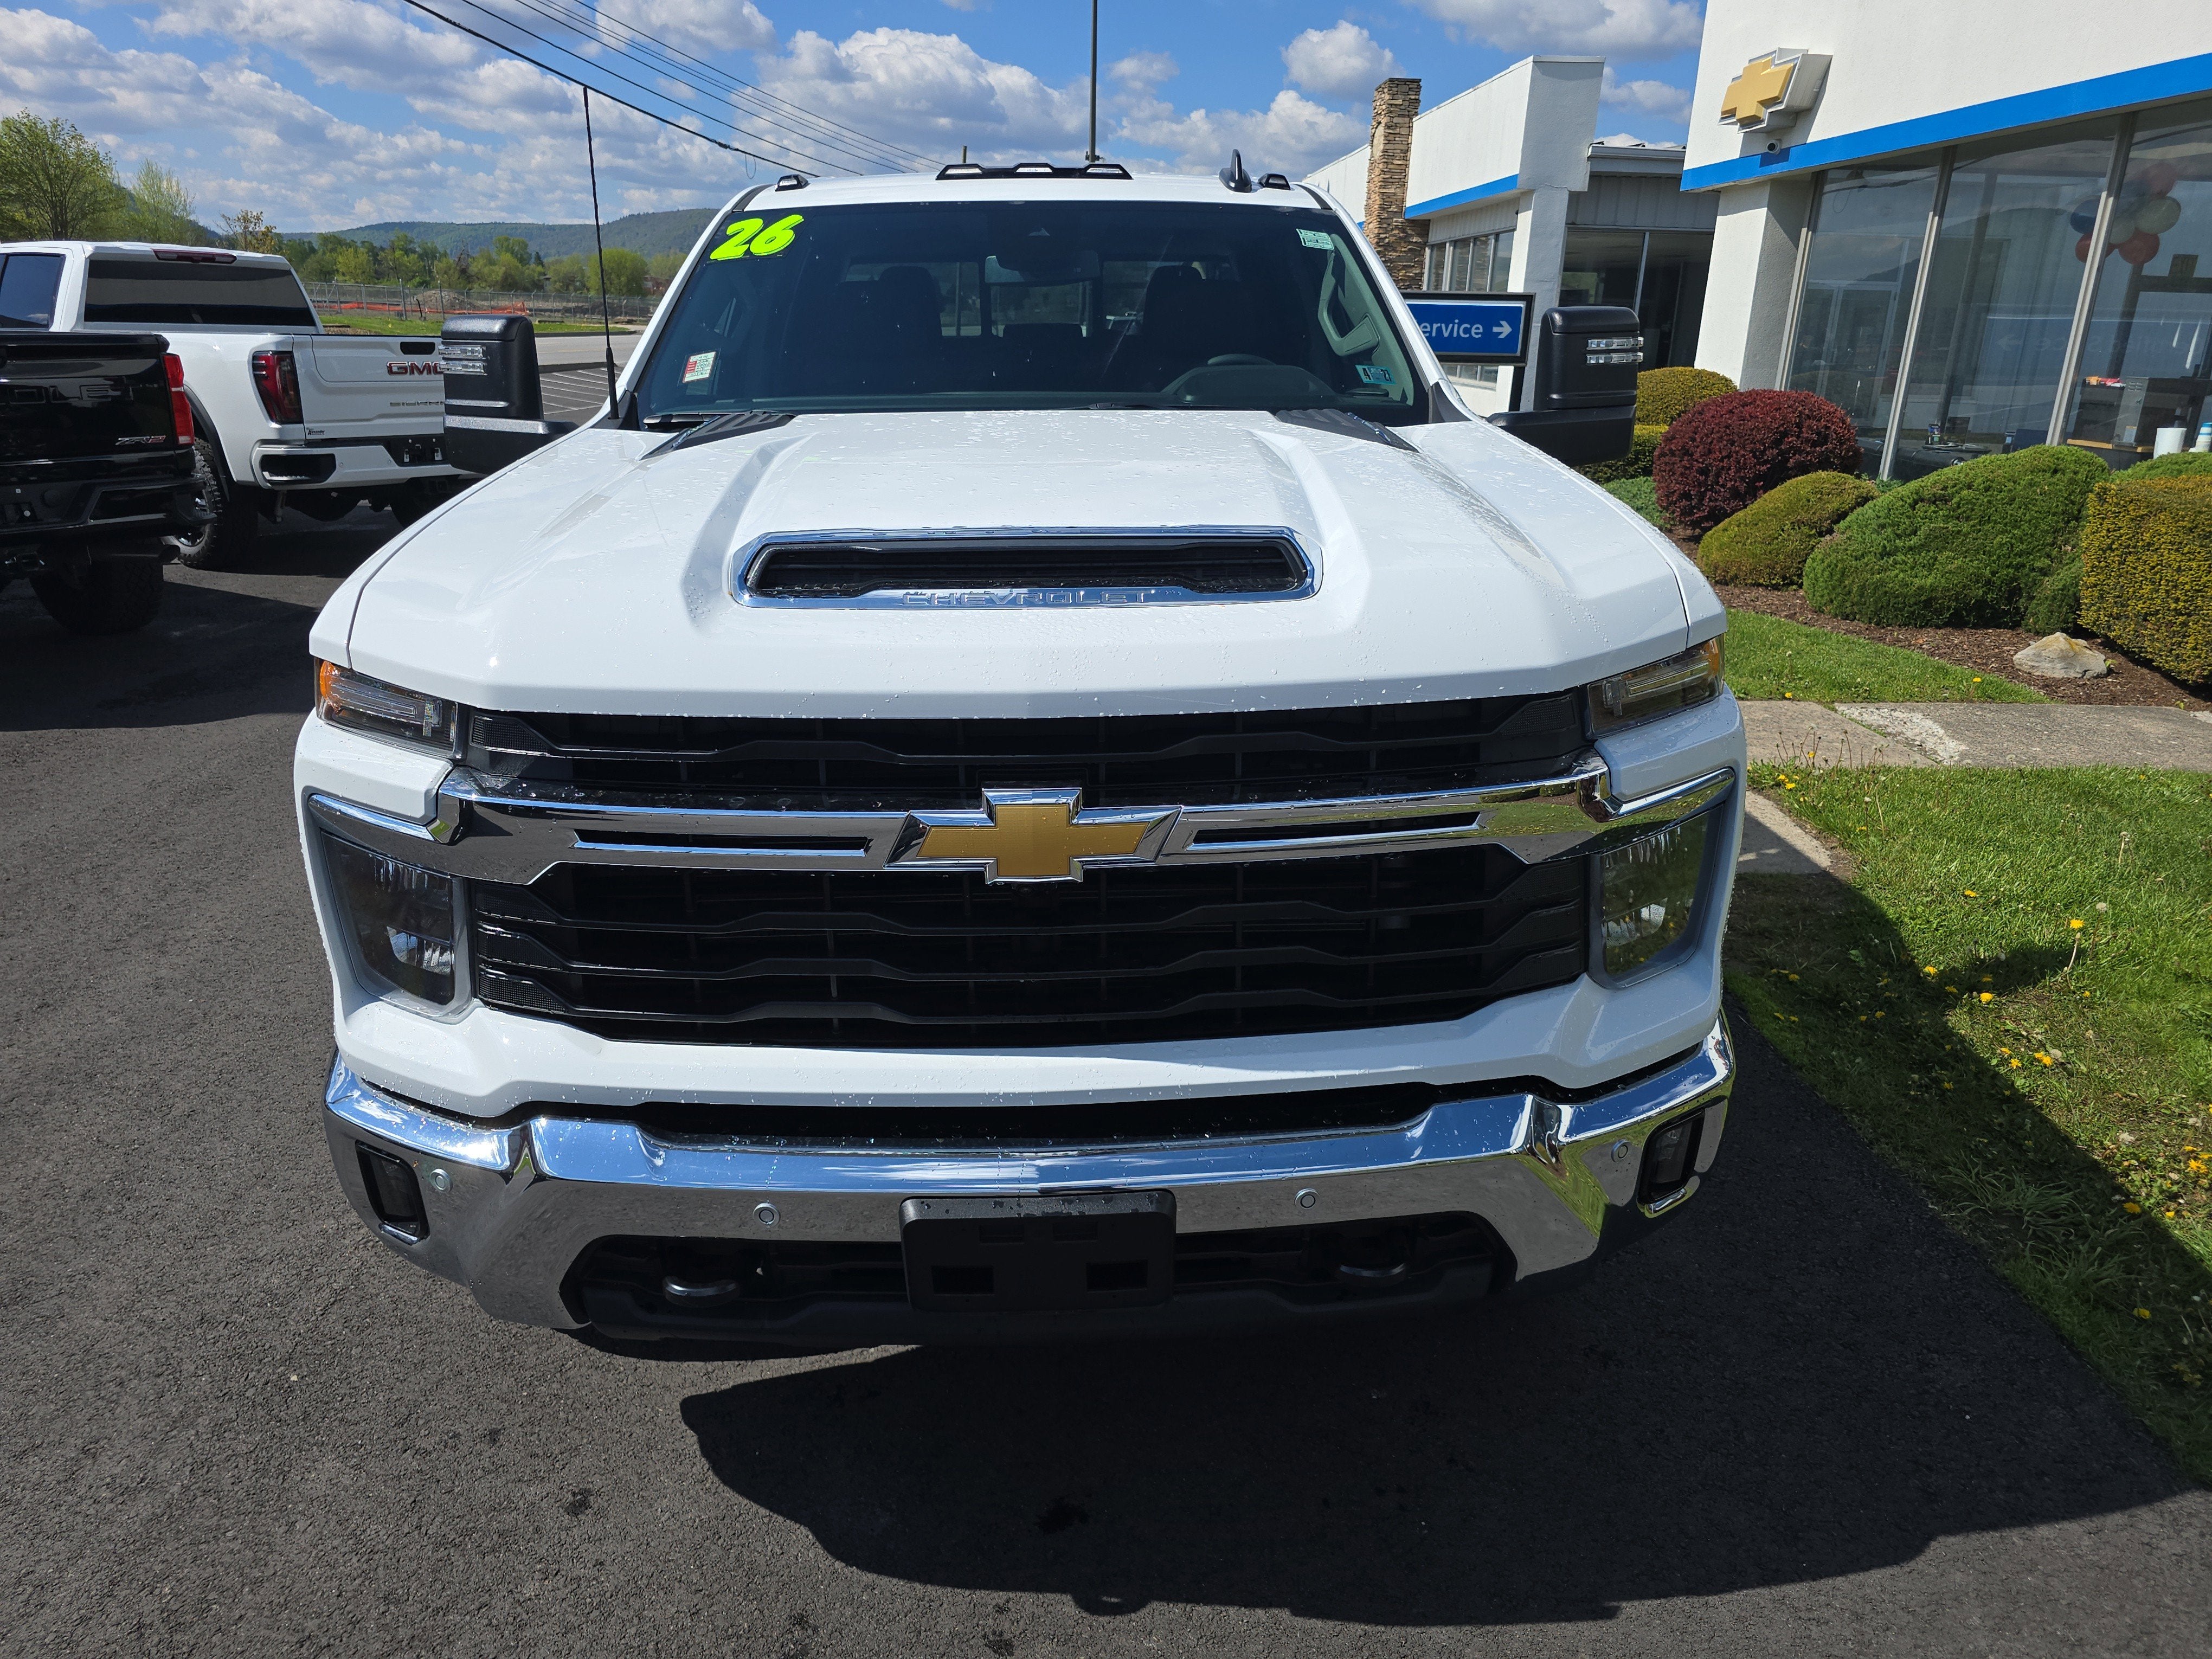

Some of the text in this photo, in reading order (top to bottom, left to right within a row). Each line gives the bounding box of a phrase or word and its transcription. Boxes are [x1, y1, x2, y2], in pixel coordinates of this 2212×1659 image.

[710, 214, 805, 261] 26
[1416, 319, 1483, 338] ervice
[1362, 368, 1372, 381] 4
[115, 435, 166, 445] ZR2
[903, 590, 1155, 606] CHEVROLET
